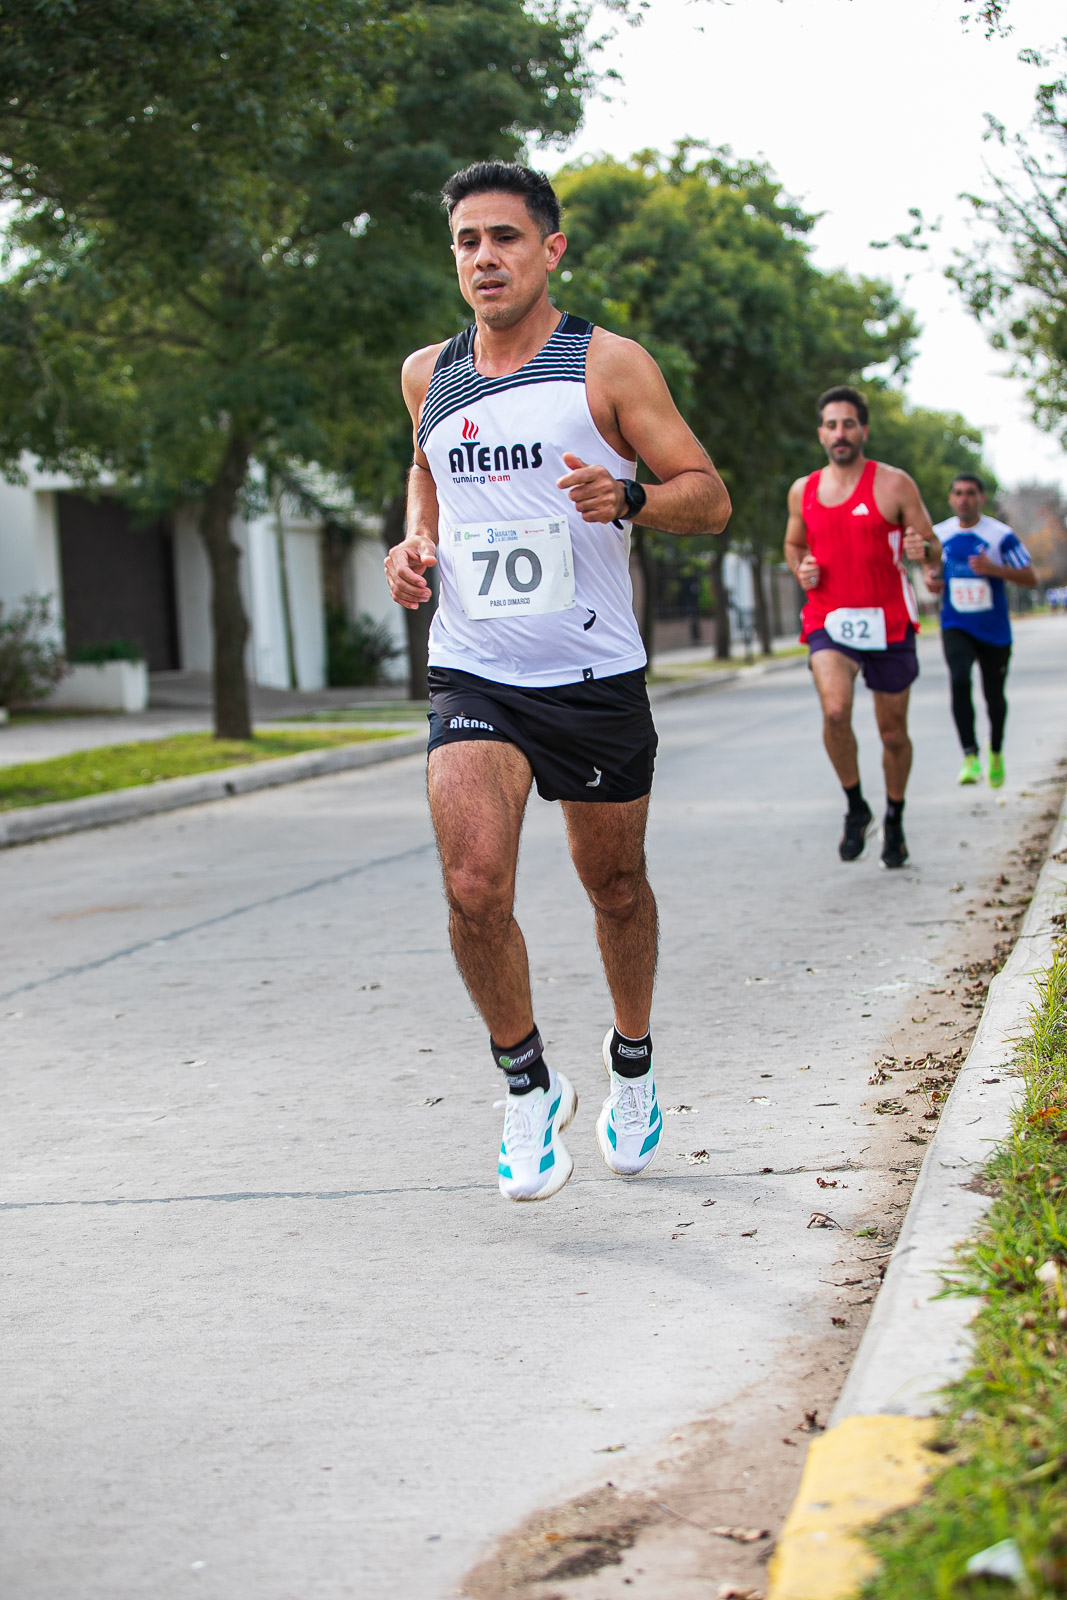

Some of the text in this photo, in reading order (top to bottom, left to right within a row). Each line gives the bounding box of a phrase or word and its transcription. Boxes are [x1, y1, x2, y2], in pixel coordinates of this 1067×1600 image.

[449, 442, 543, 473] ATENAS
[453, 474, 511, 485] running team
[487, 528, 494, 544] 3
[472, 548, 542, 596] 70
[490, 597, 530, 607] PABLO DIMARCO
[841, 620, 871, 639] 82
